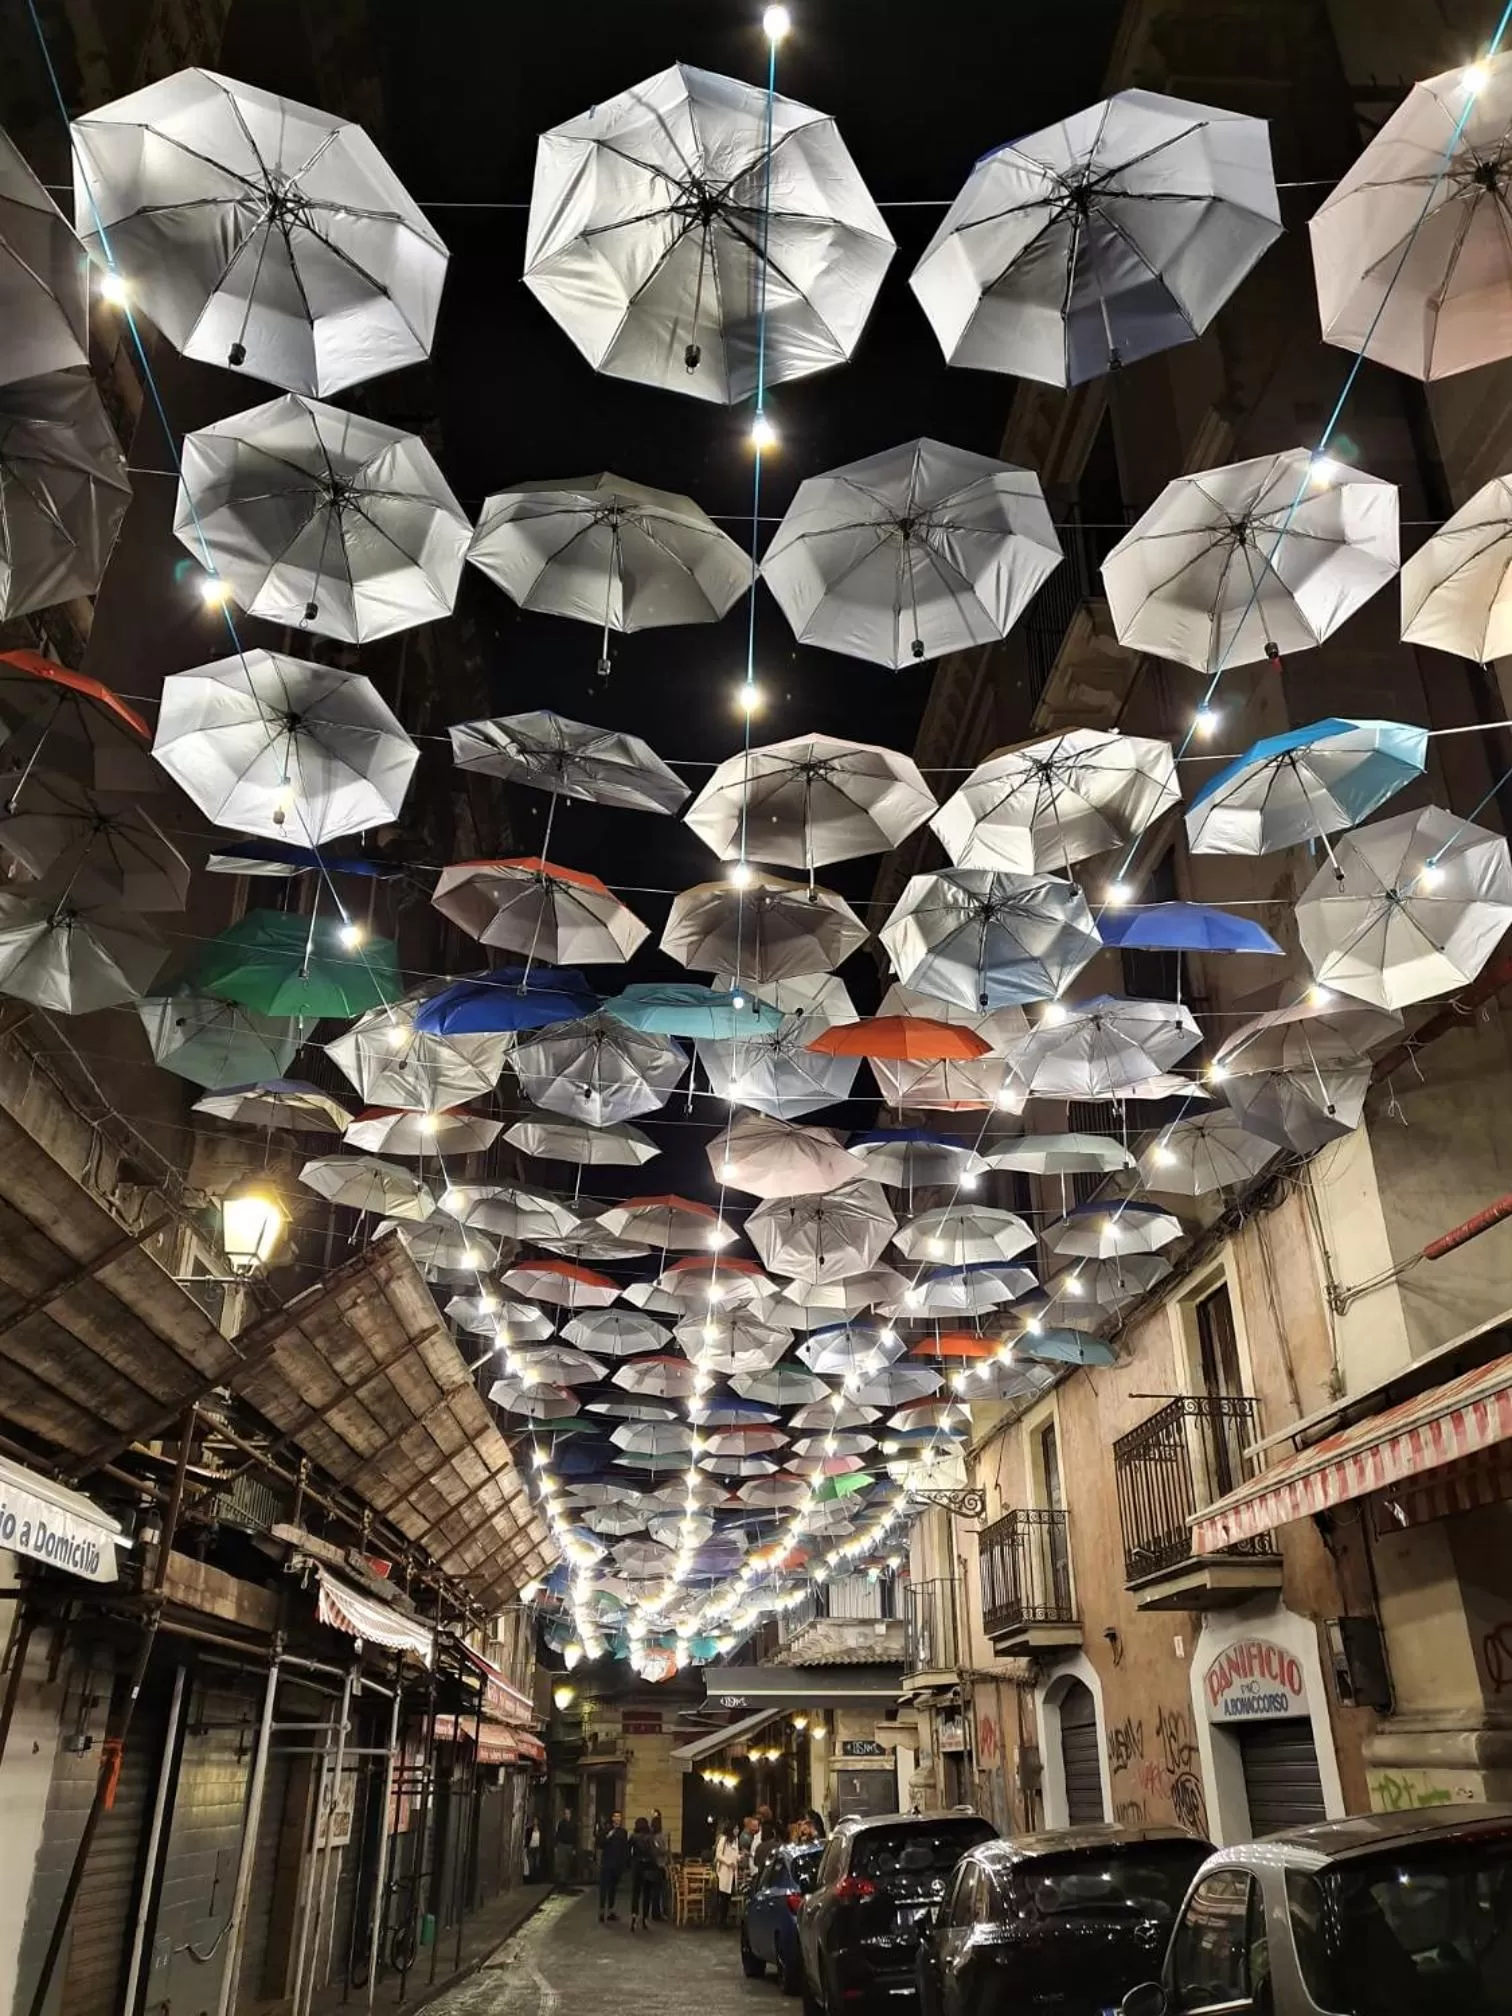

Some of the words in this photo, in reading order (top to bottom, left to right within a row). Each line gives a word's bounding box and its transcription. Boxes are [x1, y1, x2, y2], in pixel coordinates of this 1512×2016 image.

[20, 1521, 32, 1548] a
[33, 1520, 100, 1575] Domicilio
[1207, 1642, 1302, 1707] PANIFICIO
